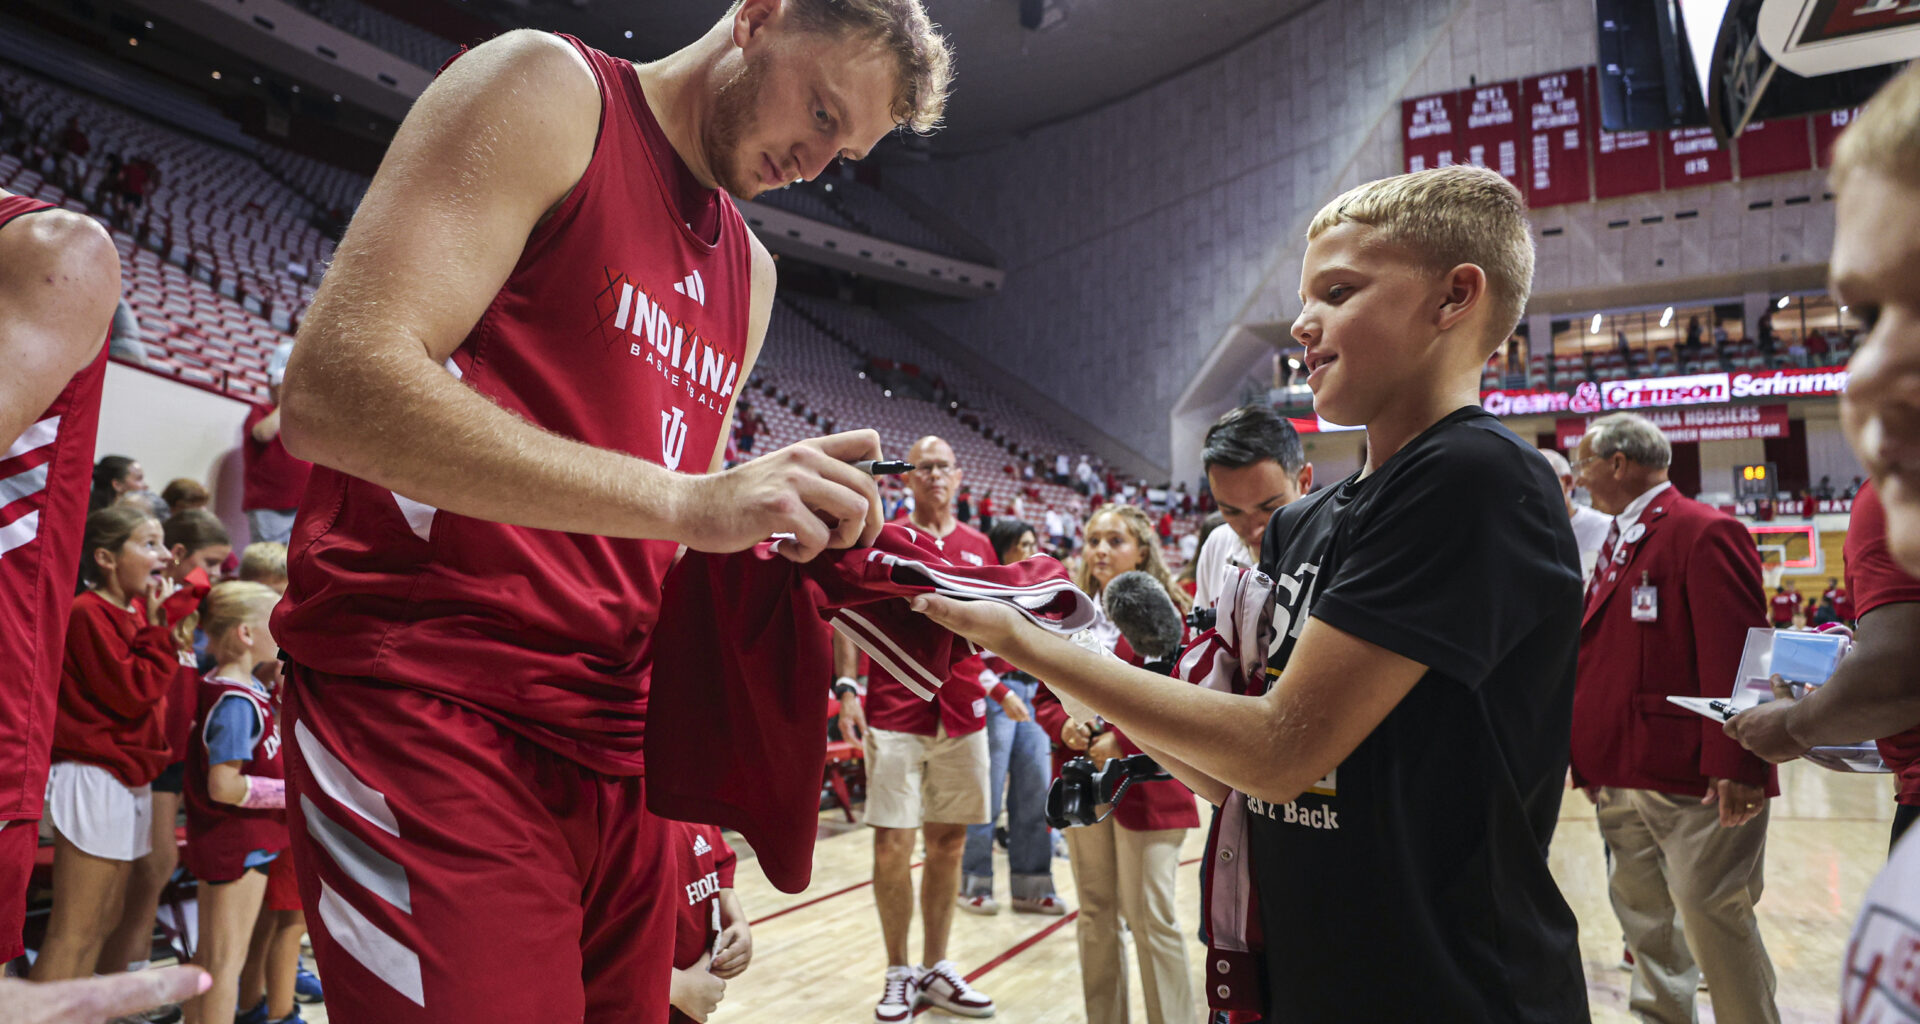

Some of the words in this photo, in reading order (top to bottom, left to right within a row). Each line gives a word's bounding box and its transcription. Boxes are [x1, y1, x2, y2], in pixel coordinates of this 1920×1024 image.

[614, 282, 737, 398] INDIANA
[630, 343, 724, 415] BASKETBALL
[1483, 390, 1570, 416] Cream
[1569, 381, 1601, 413] &
[1607, 383, 1723, 408] Crimson
[1731, 371, 1853, 398] Scrimma
[1685, 404, 1760, 426] HOOSIERS
[1700, 425, 1749, 441] MADNESS
[1751, 423, 1781, 438] TEAM
[1283, 800, 1340, 830] Back
